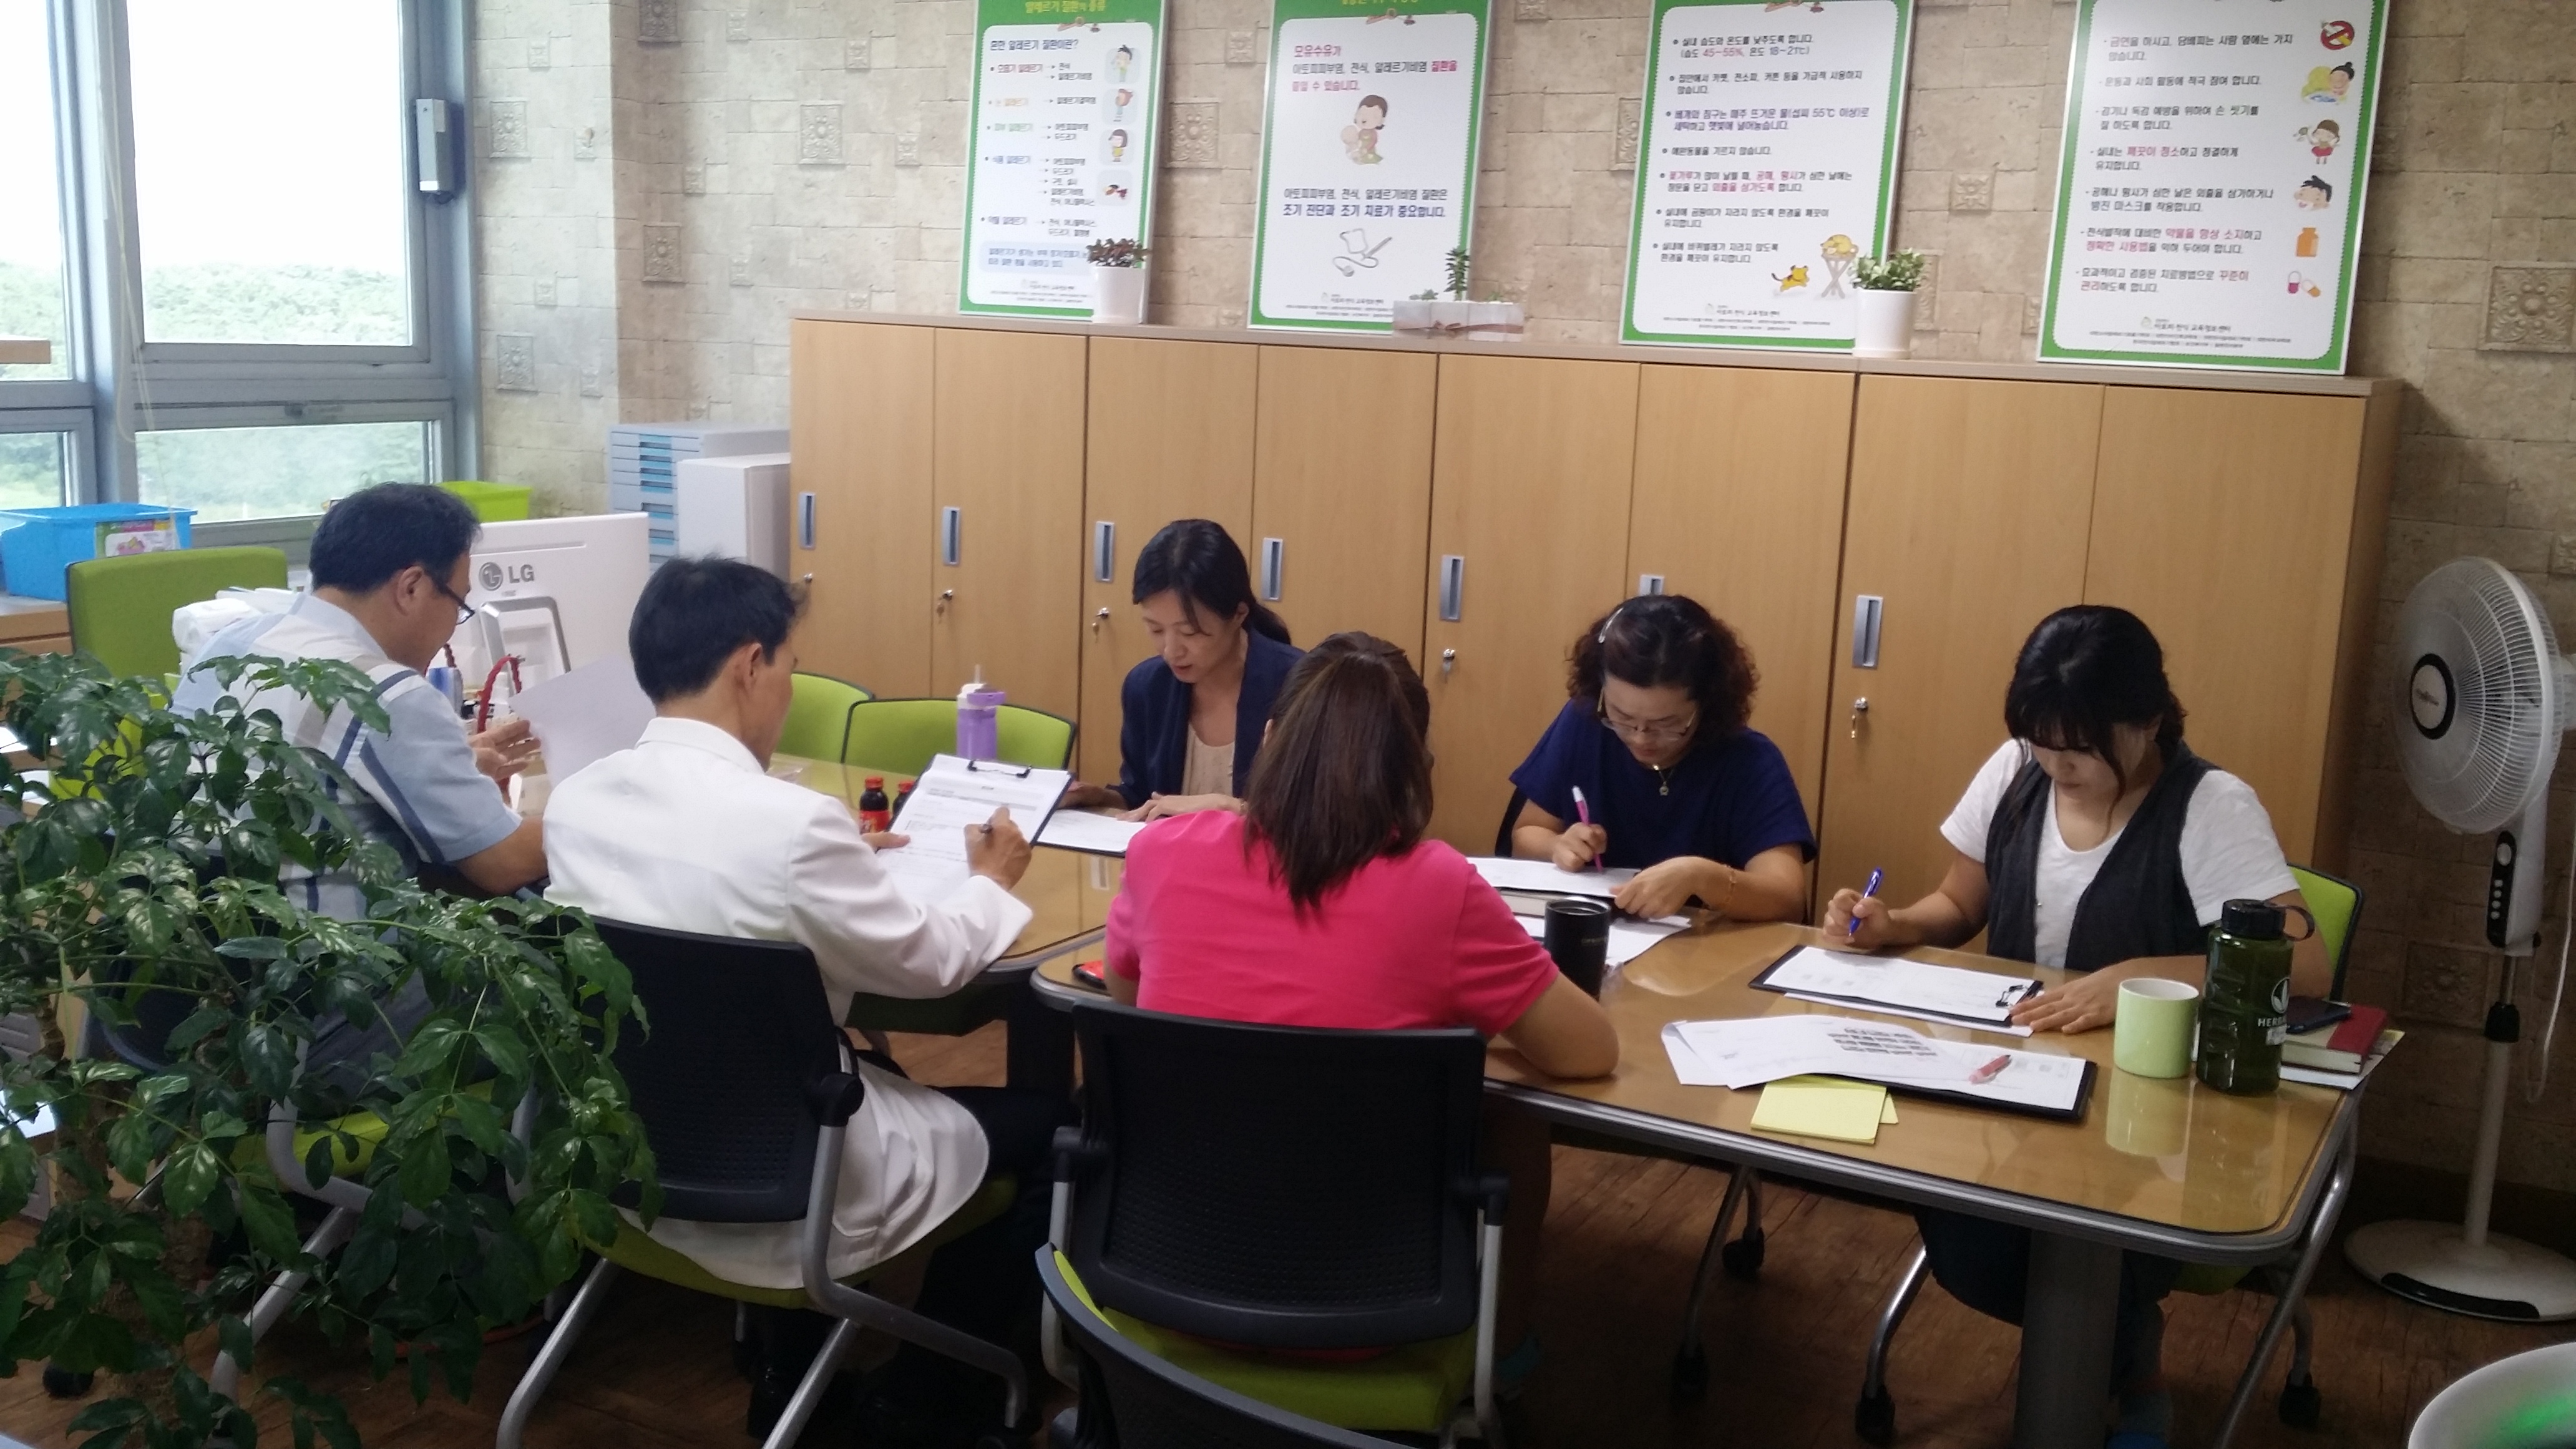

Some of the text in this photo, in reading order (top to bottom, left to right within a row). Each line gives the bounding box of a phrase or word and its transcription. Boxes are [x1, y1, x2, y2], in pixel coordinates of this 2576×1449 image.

[2275, 34, 2293, 44] 가지
[1294, 45, 1341, 57] 모유수유가
[1375, 61, 1427, 73] 알레르기비염
[1312, 81, 1320, 90] 수
[1366, 188, 1417, 200] 알레르기비염
[1283, 204, 1302, 216] 조기
[1306, 204, 1335, 217] 진단과
[1340, 205, 1360, 217] 조기
[1365, 205, 1393, 217] 치료가
[508, 564, 535, 583] LG
